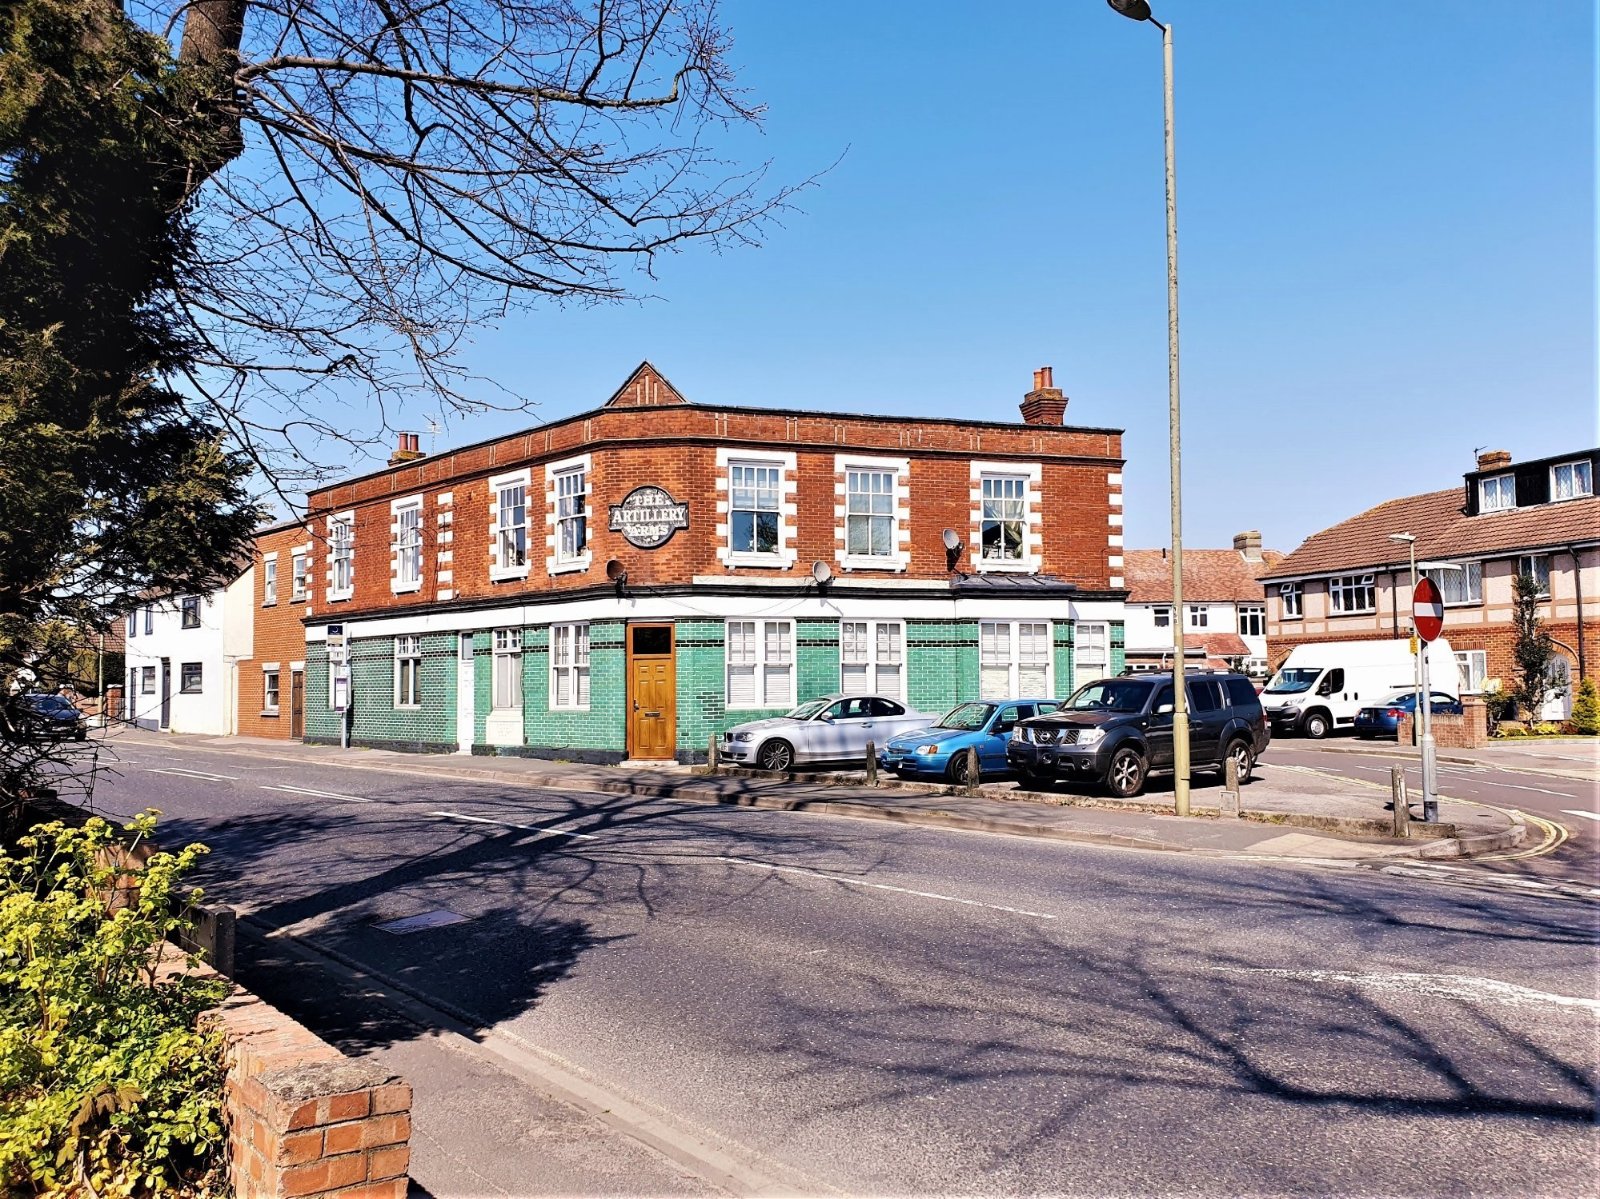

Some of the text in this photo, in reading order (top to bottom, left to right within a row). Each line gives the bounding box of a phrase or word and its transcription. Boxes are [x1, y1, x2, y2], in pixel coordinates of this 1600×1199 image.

[633, 494, 664, 506] THE
[612, 507, 686, 523] ARTILLERY
[628, 524, 669, 537] ARMS
